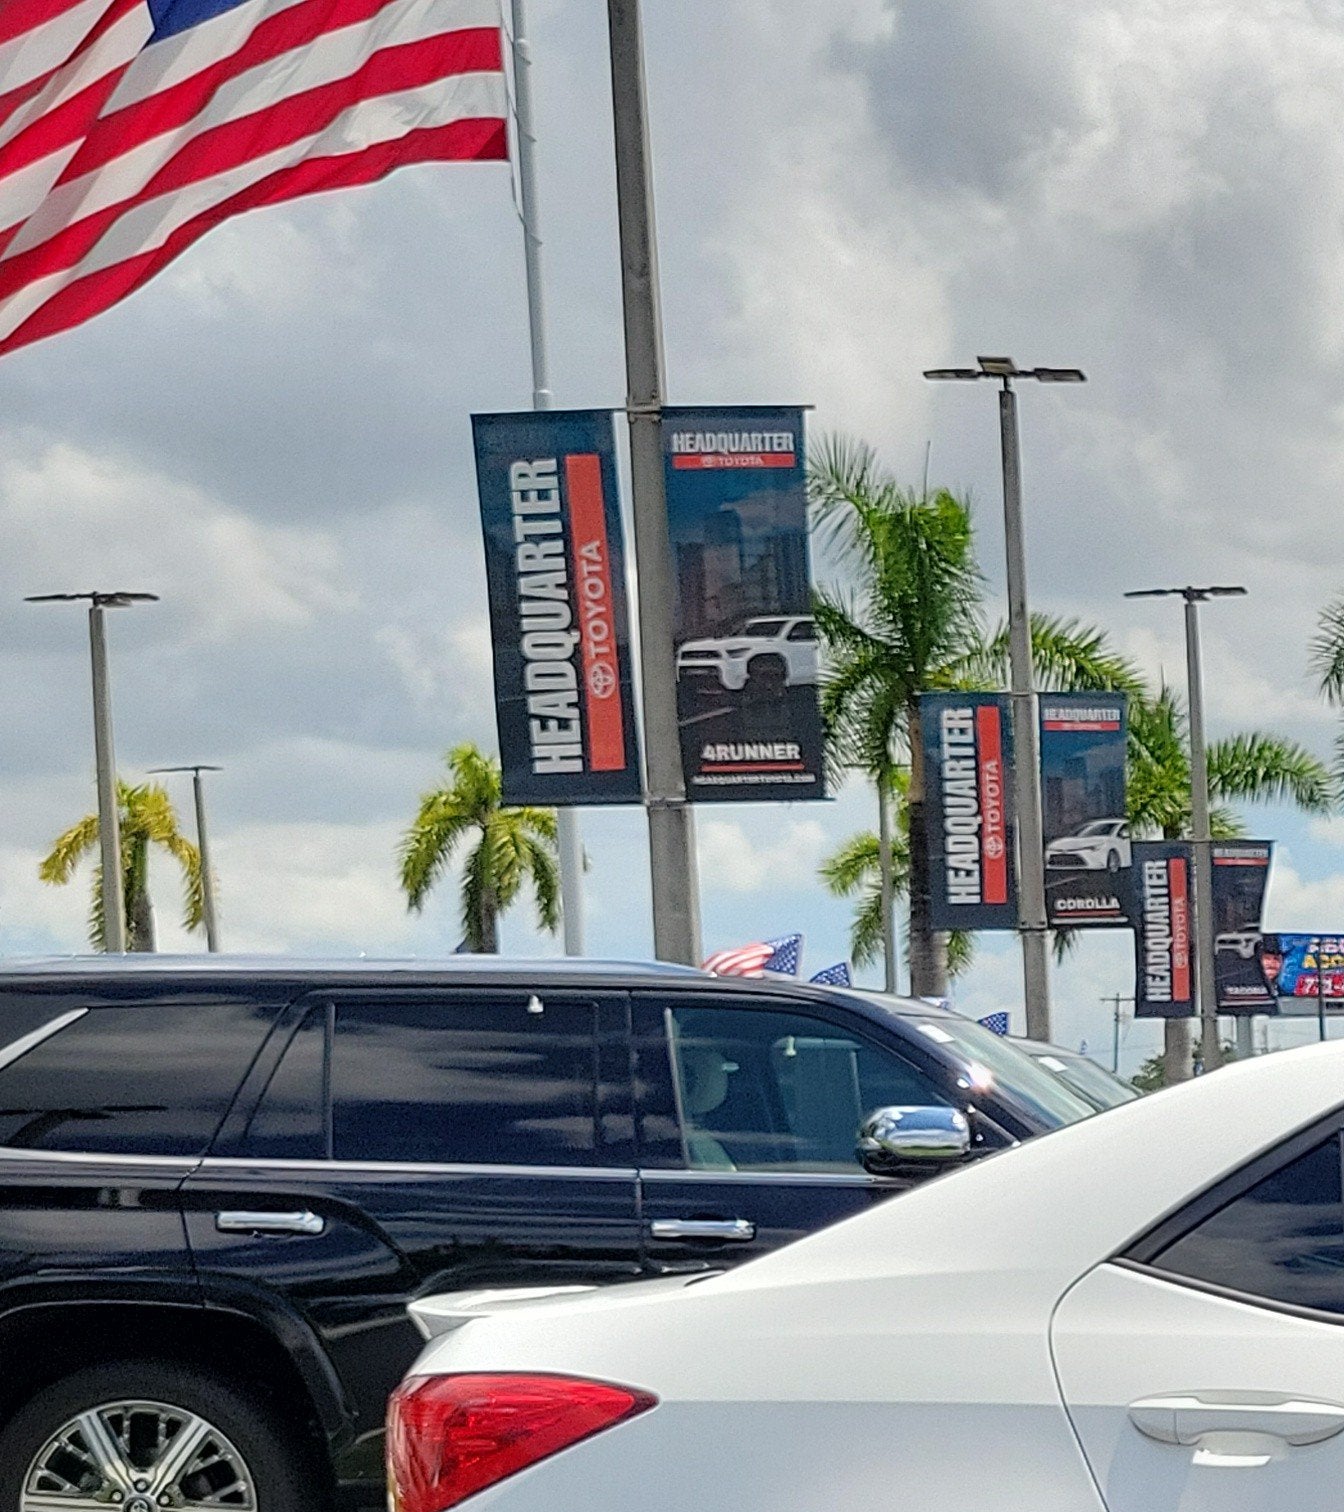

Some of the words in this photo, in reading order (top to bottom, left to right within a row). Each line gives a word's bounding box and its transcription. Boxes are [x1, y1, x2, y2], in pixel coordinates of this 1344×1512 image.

[672, 432, 795, 454] HEADQUARTER
[510, 457, 584, 774] HEADQUARTER
[580, 540, 606, 657] TOYOTA
[1044, 708, 1121, 721] HEADQUARTER
[702, 742, 800, 761] 4RUNNER
[942, 707, 983, 904] HEADQUARTER
[985, 760, 1002, 834] TOYOTA
[1055, 898, 1121, 911] COROLLA
[1144, 860, 1173, 1001] HEADQUARTER
[1174, 897, 1188, 952] TOYOTA
